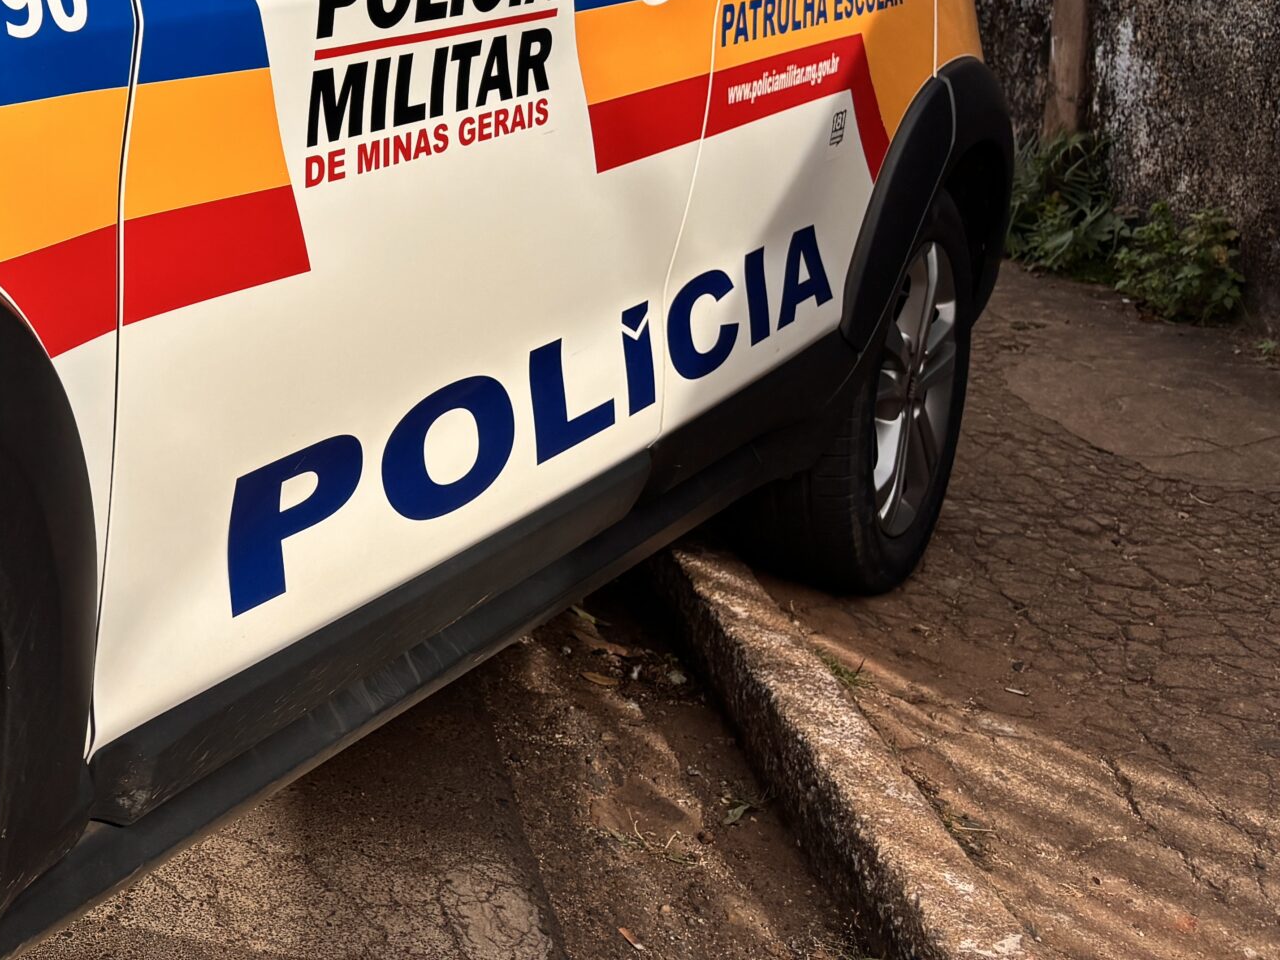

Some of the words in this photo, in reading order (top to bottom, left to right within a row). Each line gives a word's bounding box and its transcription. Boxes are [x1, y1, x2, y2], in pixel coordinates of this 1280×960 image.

[306, 27, 553, 148] MILITAR
[727, 52, 840, 105] www.policiamilitar.mg.gov.br
[305, 148, 346, 189] DE
[357, 123, 449, 175] MINAS
[458, 98, 550, 147] GERAIS
